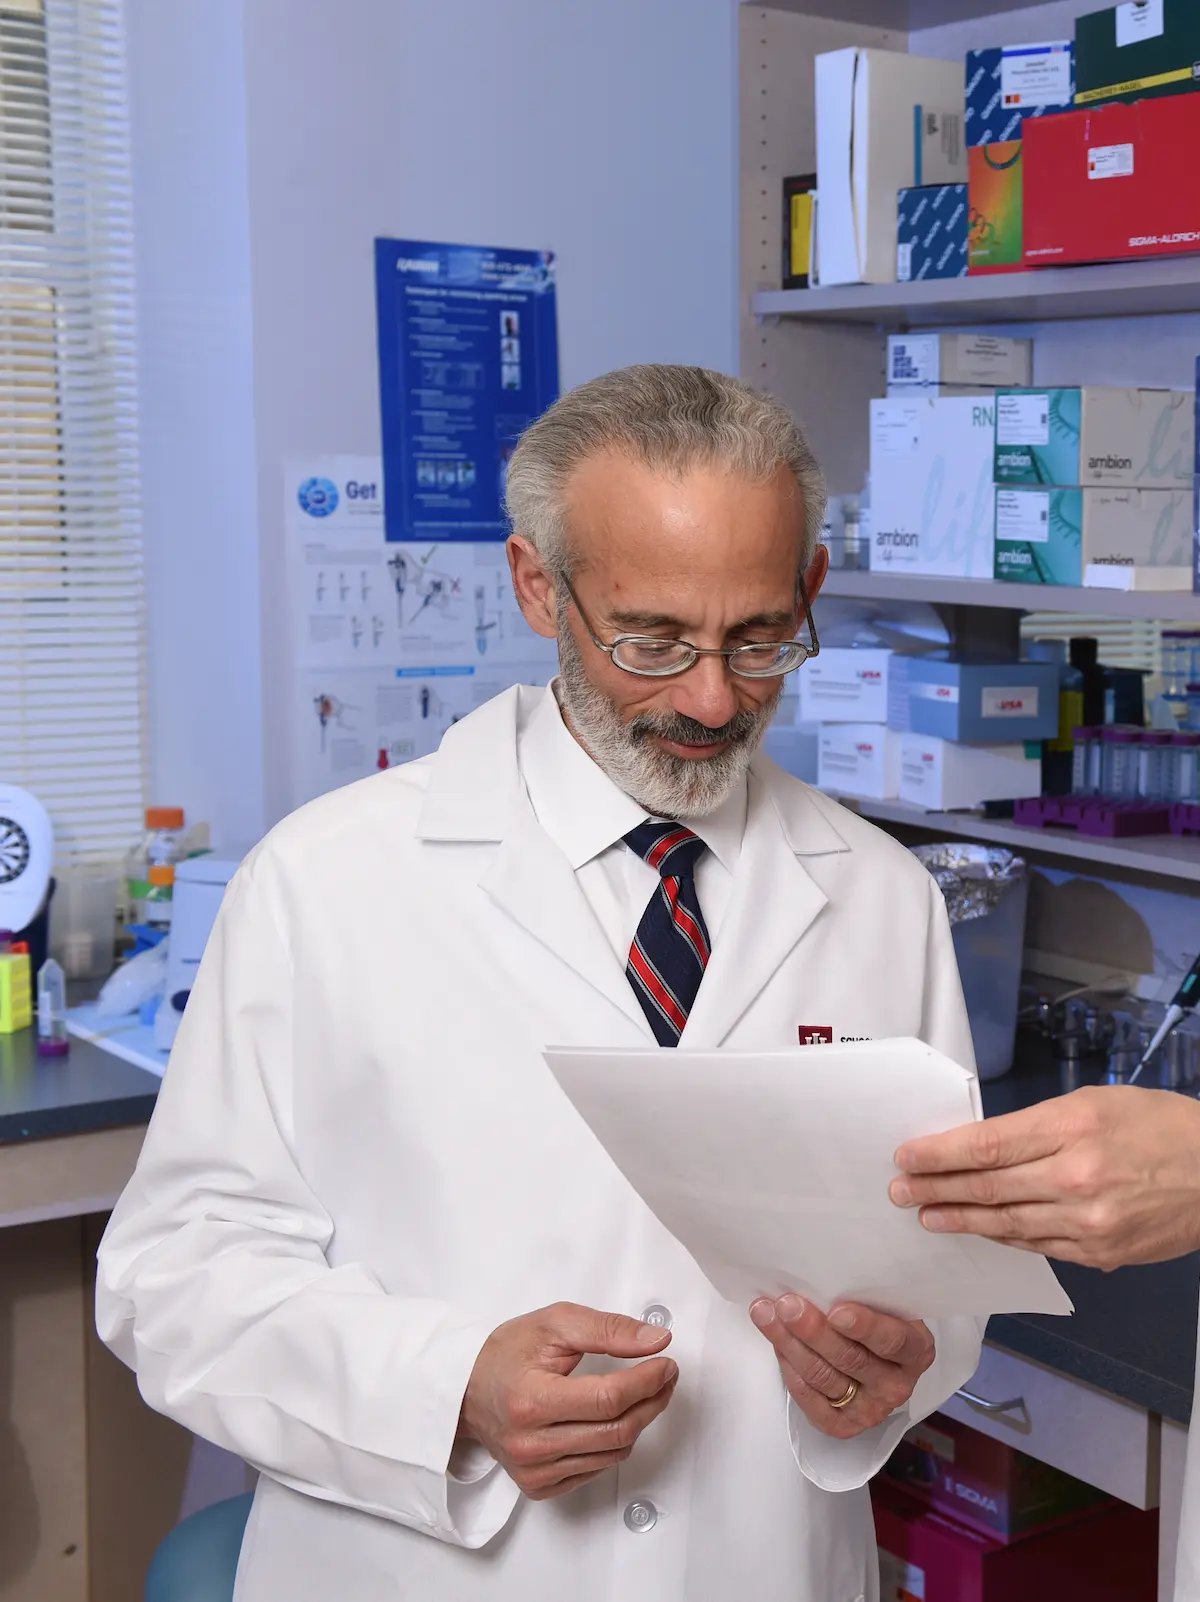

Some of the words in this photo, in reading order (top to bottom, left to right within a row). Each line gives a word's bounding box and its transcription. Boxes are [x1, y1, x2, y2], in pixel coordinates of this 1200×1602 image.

[1128, 231, 1200, 247] SIGMA-ALDRICH
[997, 451, 1031, 466] ambion
[1088, 454, 1132, 469] ambion
[346, 481, 376, 500] Get
[876, 528, 919, 548] ambion
[997, 548, 1032, 564] ambion
[1001, 700, 1023, 710] USA
